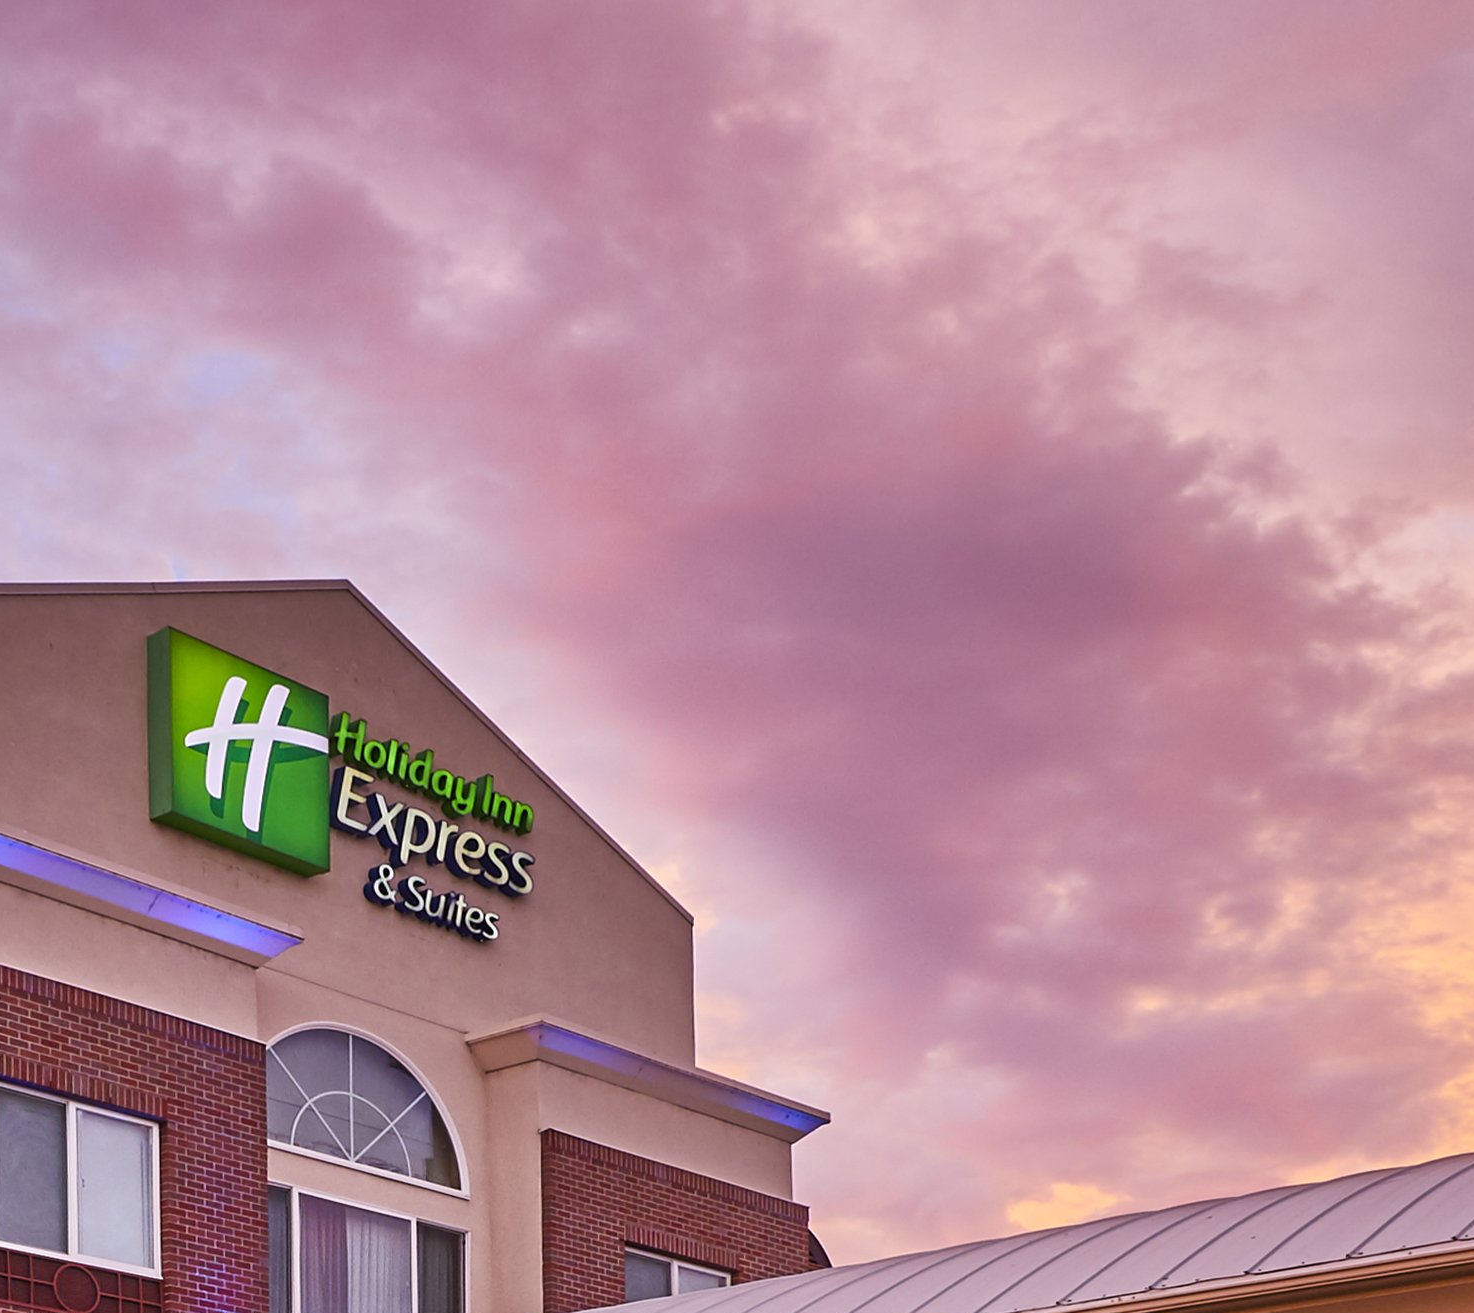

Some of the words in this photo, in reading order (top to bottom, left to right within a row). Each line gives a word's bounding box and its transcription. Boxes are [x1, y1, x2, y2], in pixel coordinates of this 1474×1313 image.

[333, 712, 478, 815] Holiday
[483, 774, 534, 834] Inn
[335, 766, 535, 895] Express
[372, 863, 398, 902] &
[404, 875, 501, 941] Suites
